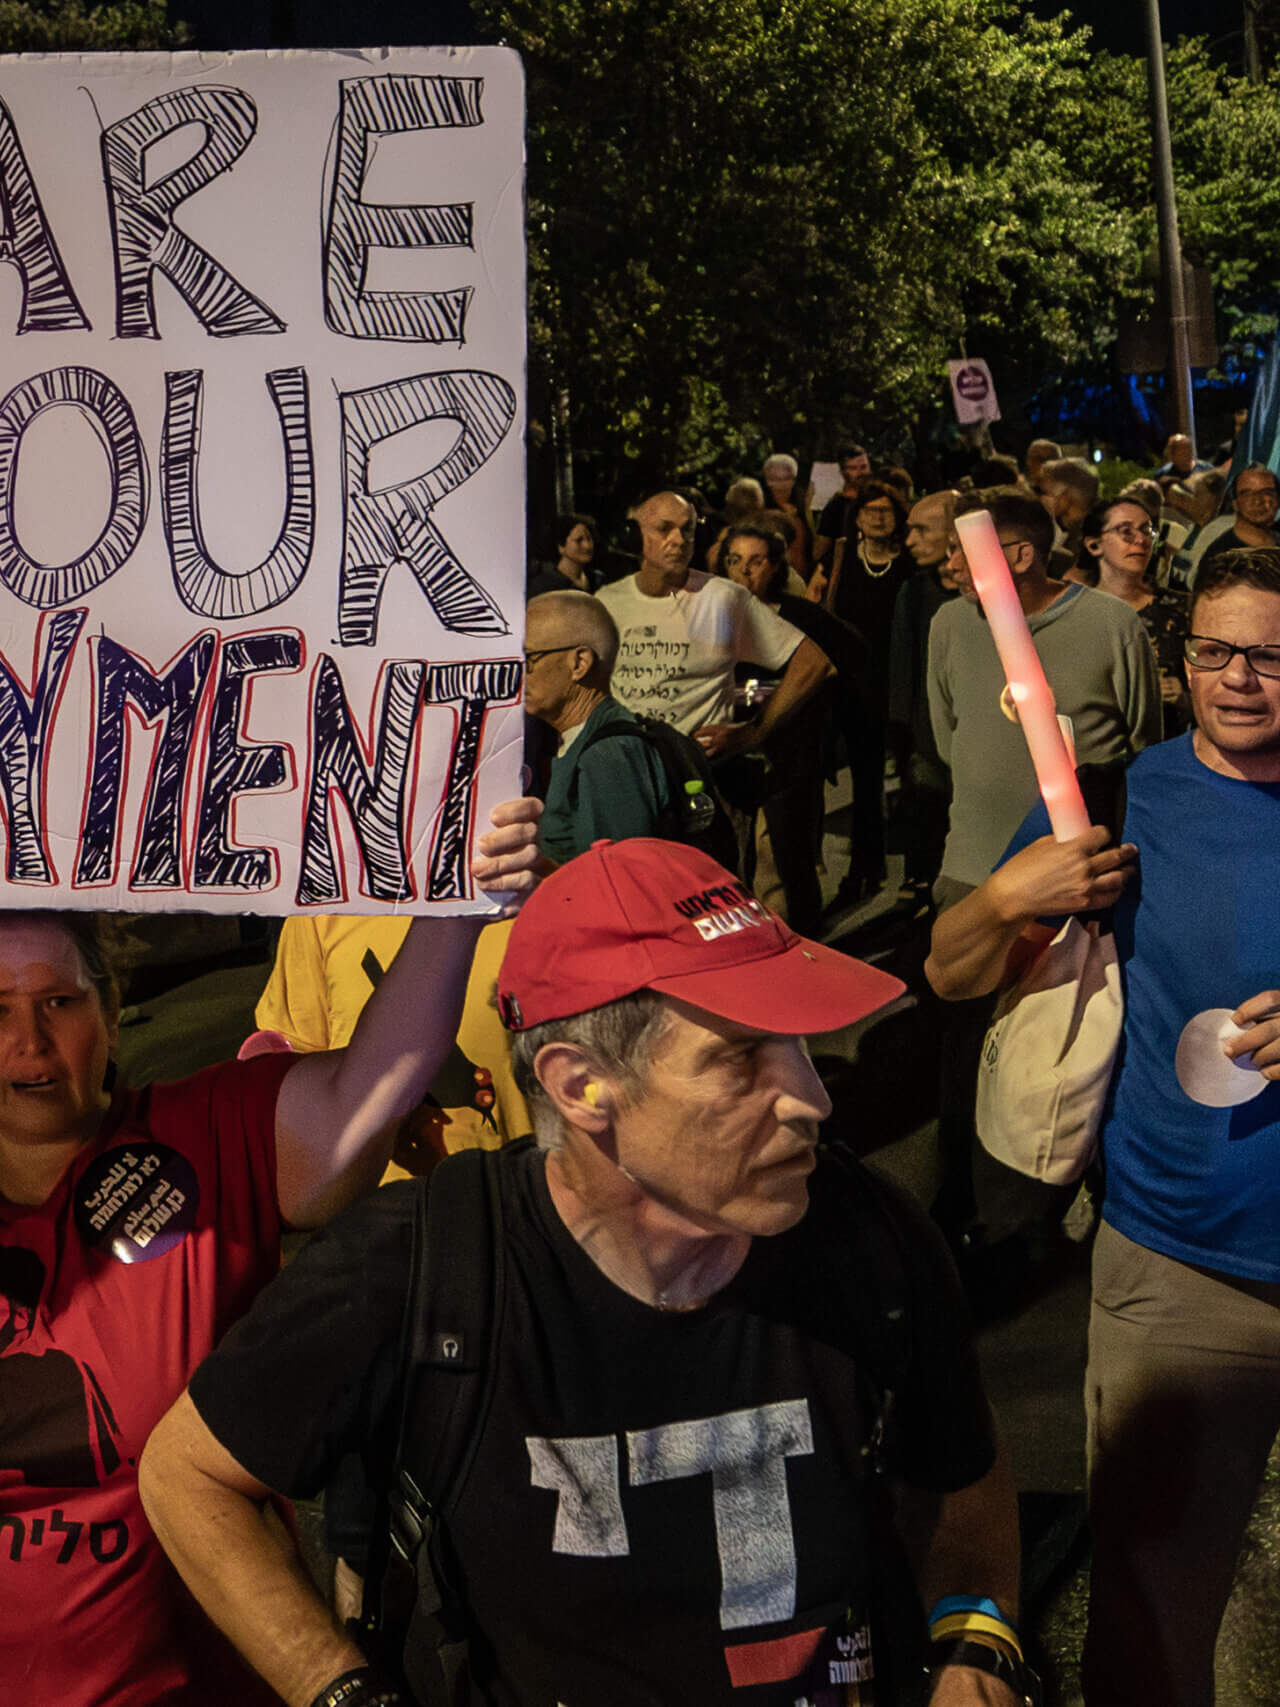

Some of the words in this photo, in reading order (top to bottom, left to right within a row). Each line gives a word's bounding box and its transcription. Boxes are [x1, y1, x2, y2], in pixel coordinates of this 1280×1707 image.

[121, 1151, 139, 1168] لا
[139, 1154, 161, 1177] לא
[84, 1162, 127, 1209] للحرب
[89, 1172, 144, 1232] למלחמה
[132, 1203, 173, 1248] שלום
